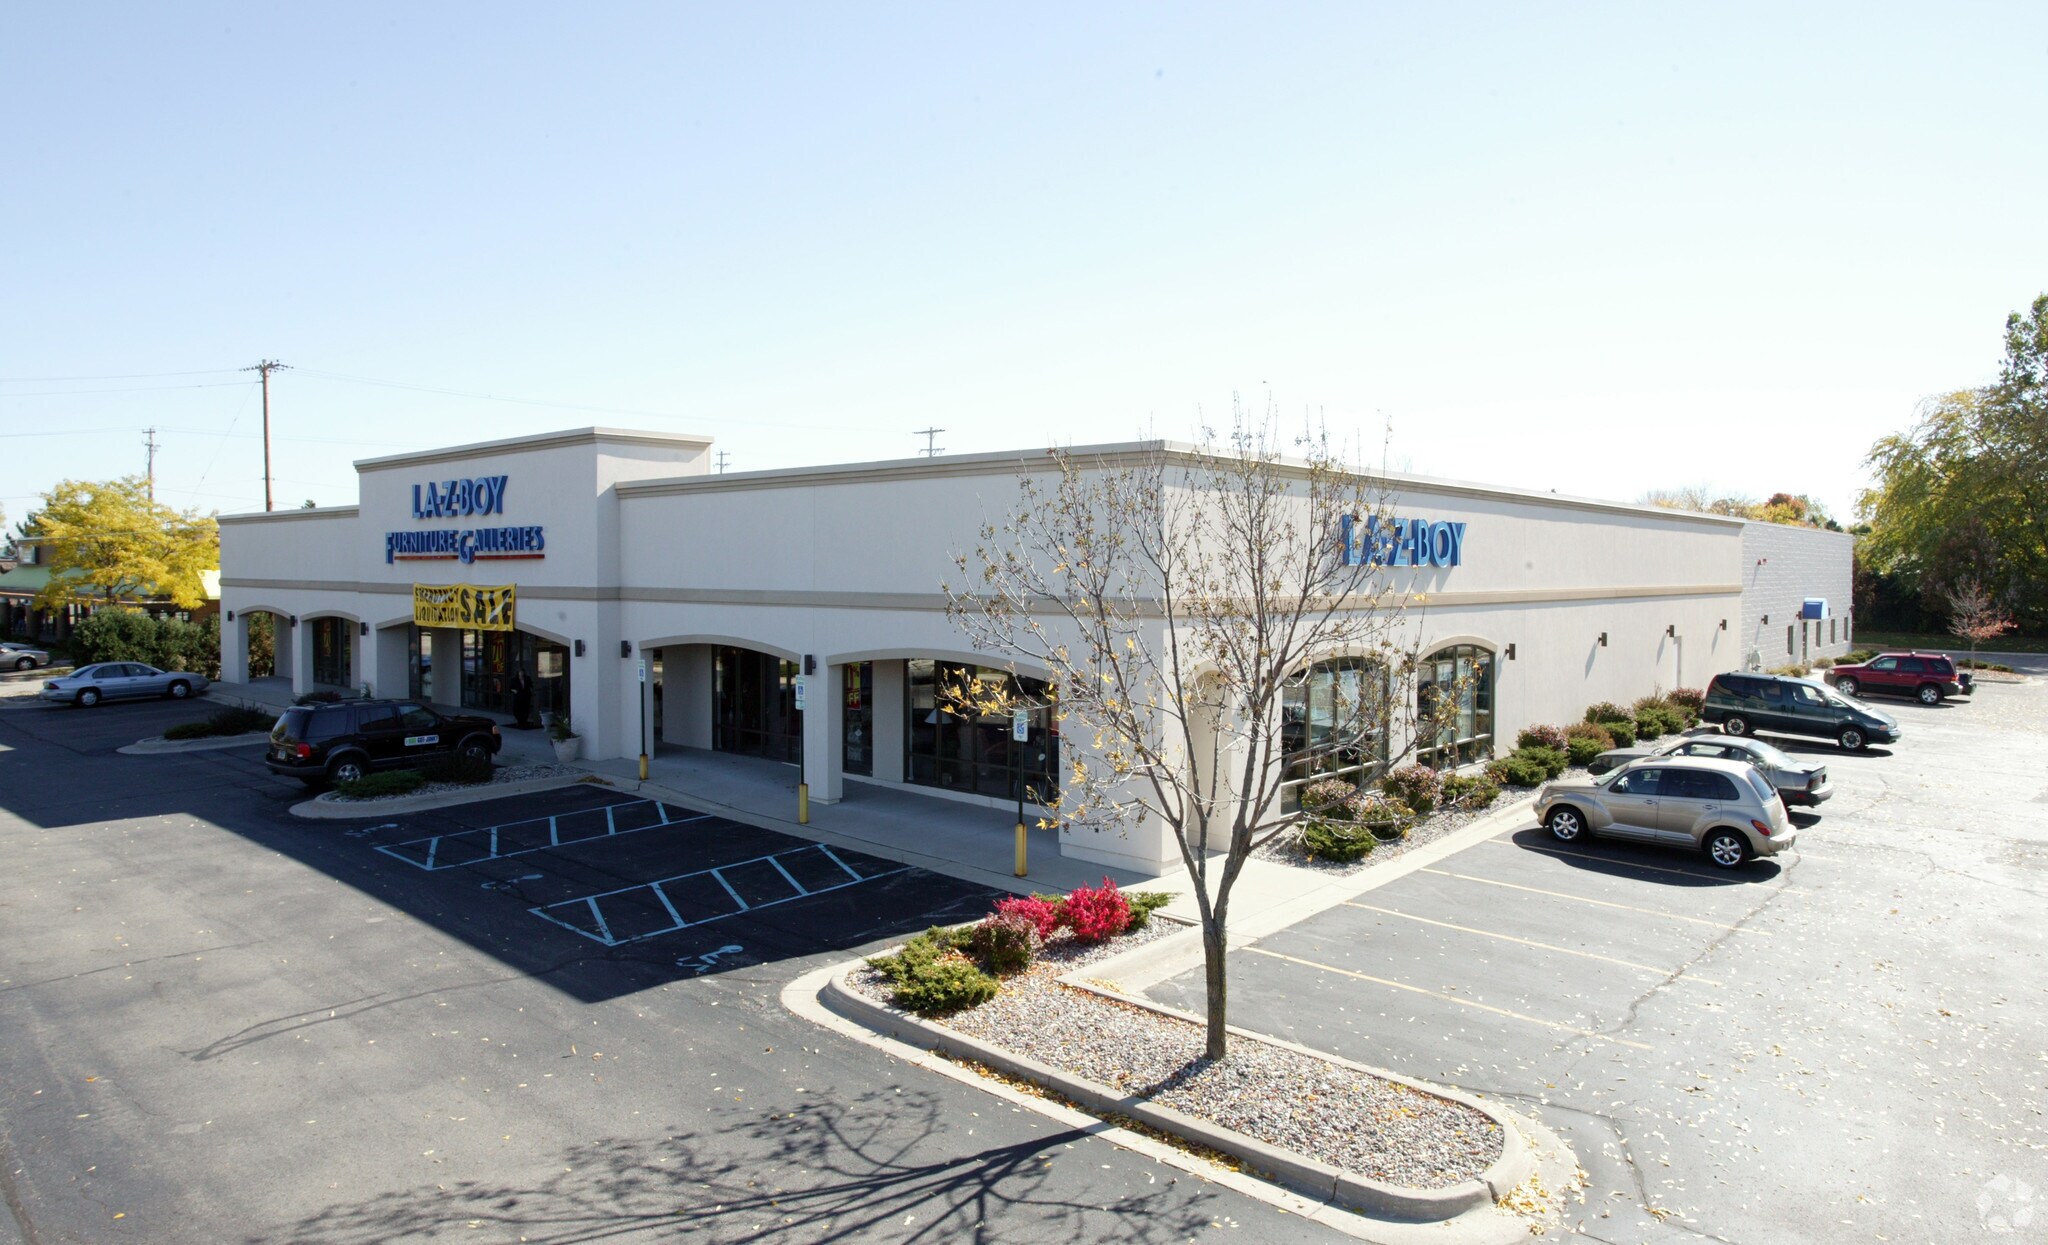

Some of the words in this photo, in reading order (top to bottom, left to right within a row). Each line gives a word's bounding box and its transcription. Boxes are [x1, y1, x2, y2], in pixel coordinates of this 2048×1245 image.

[411, 475, 509, 519] LA-Z-BOY
[385, 530, 459, 564] FURNITURE
[458, 526, 545, 564] GALLERIES
[1341, 513, 1468, 569] LA-Z-BOY
[460, 588, 512, 624] SALE
